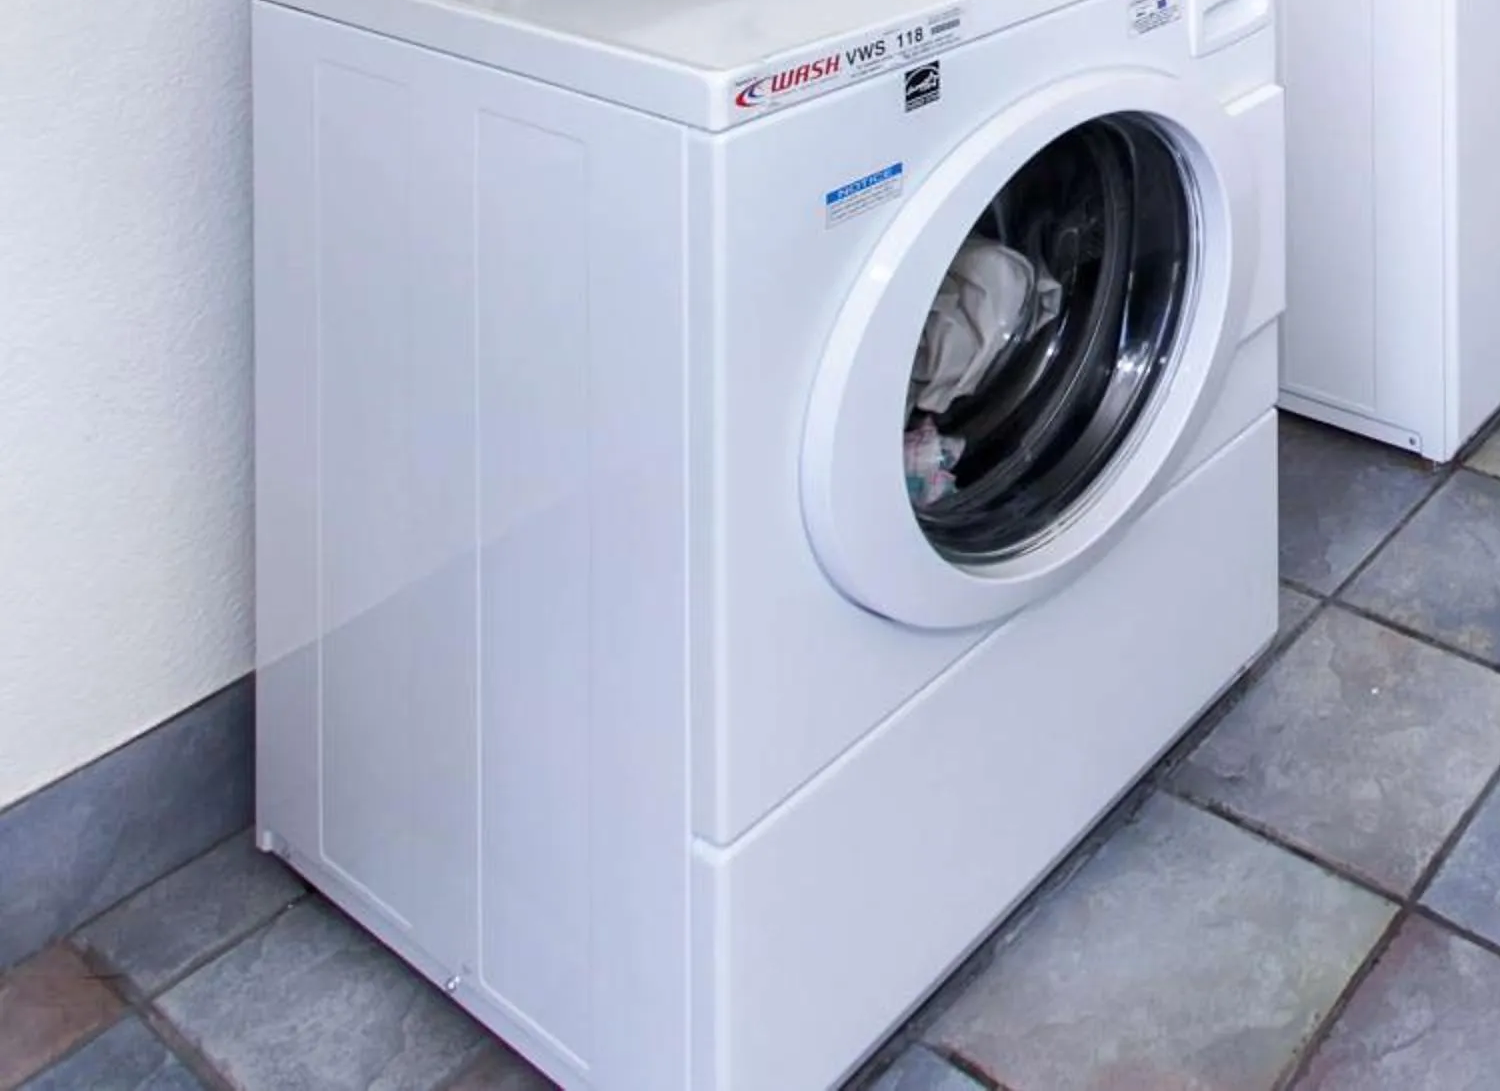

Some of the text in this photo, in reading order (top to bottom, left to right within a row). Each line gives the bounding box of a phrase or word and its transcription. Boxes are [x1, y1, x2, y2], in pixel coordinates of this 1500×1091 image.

[771, 54, 840, 94] WASH
[845, 40, 886, 66] VWS
[897, 26, 923, 48] 118
